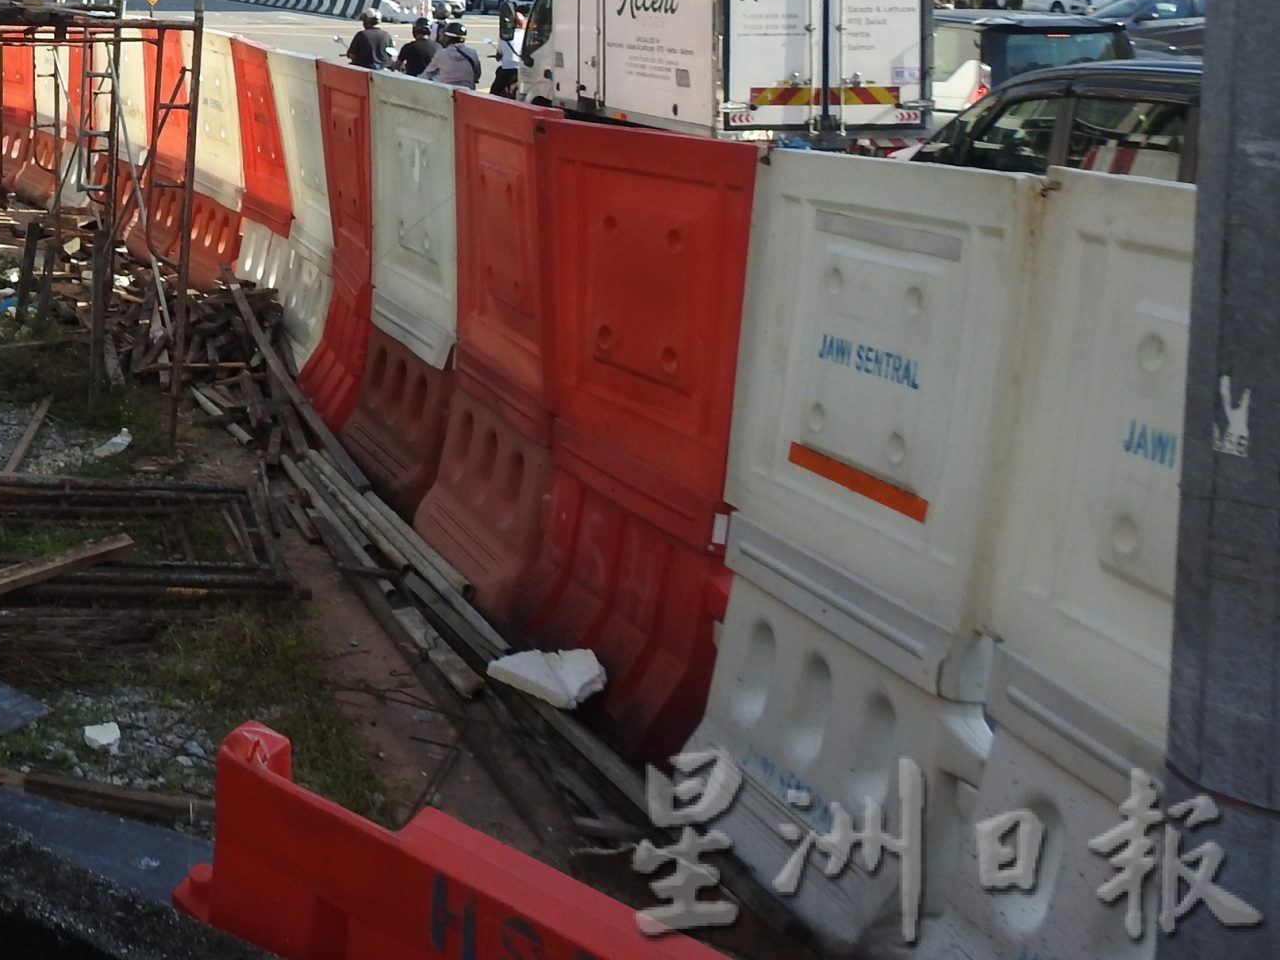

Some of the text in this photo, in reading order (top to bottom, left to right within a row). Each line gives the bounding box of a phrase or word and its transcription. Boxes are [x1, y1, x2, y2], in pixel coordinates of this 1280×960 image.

[818, 334, 919, 390] JAWI SENTRAL
[1123, 420, 1178, 468] JAWI
